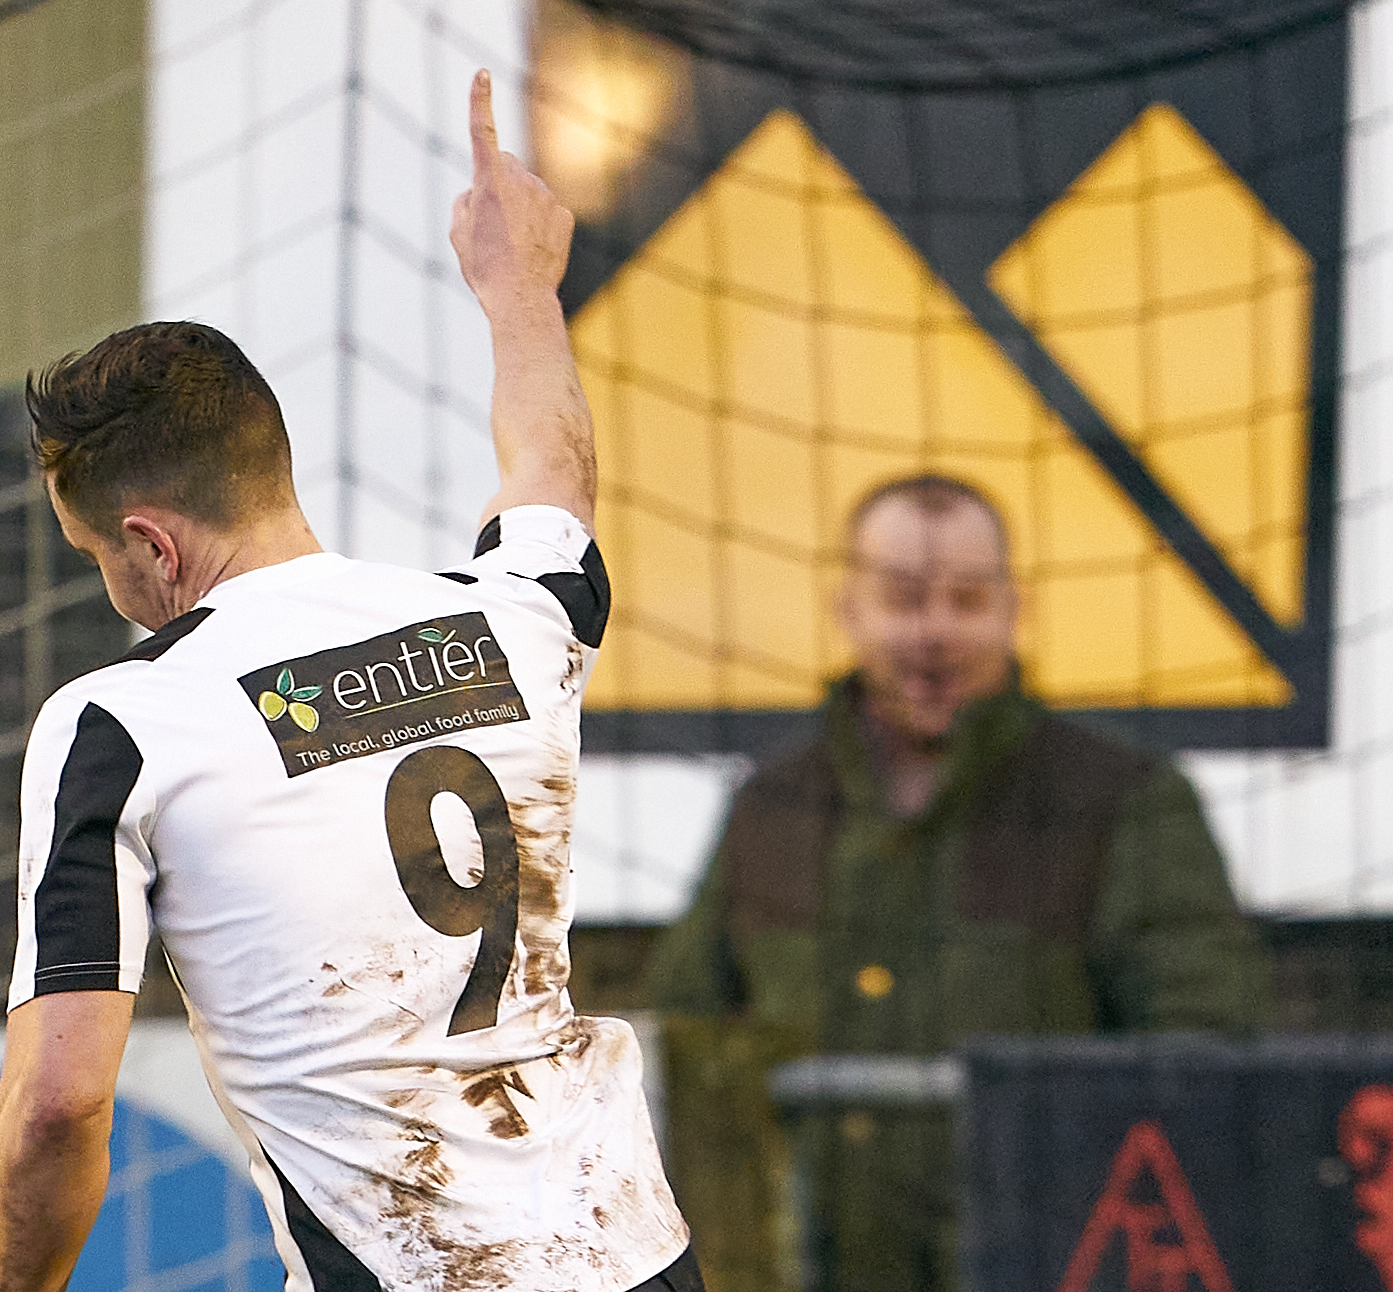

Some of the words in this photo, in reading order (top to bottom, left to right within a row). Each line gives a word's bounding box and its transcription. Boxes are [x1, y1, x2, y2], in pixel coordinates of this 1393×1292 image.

[296, 749, 331, 768] The
[332, 734, 381, 758] local,
[381, 719, 435, 750] global
[435, 705, 473, 731] food
[473, 703, 521, 726] family
[384, 744, 521, 1038] 9
